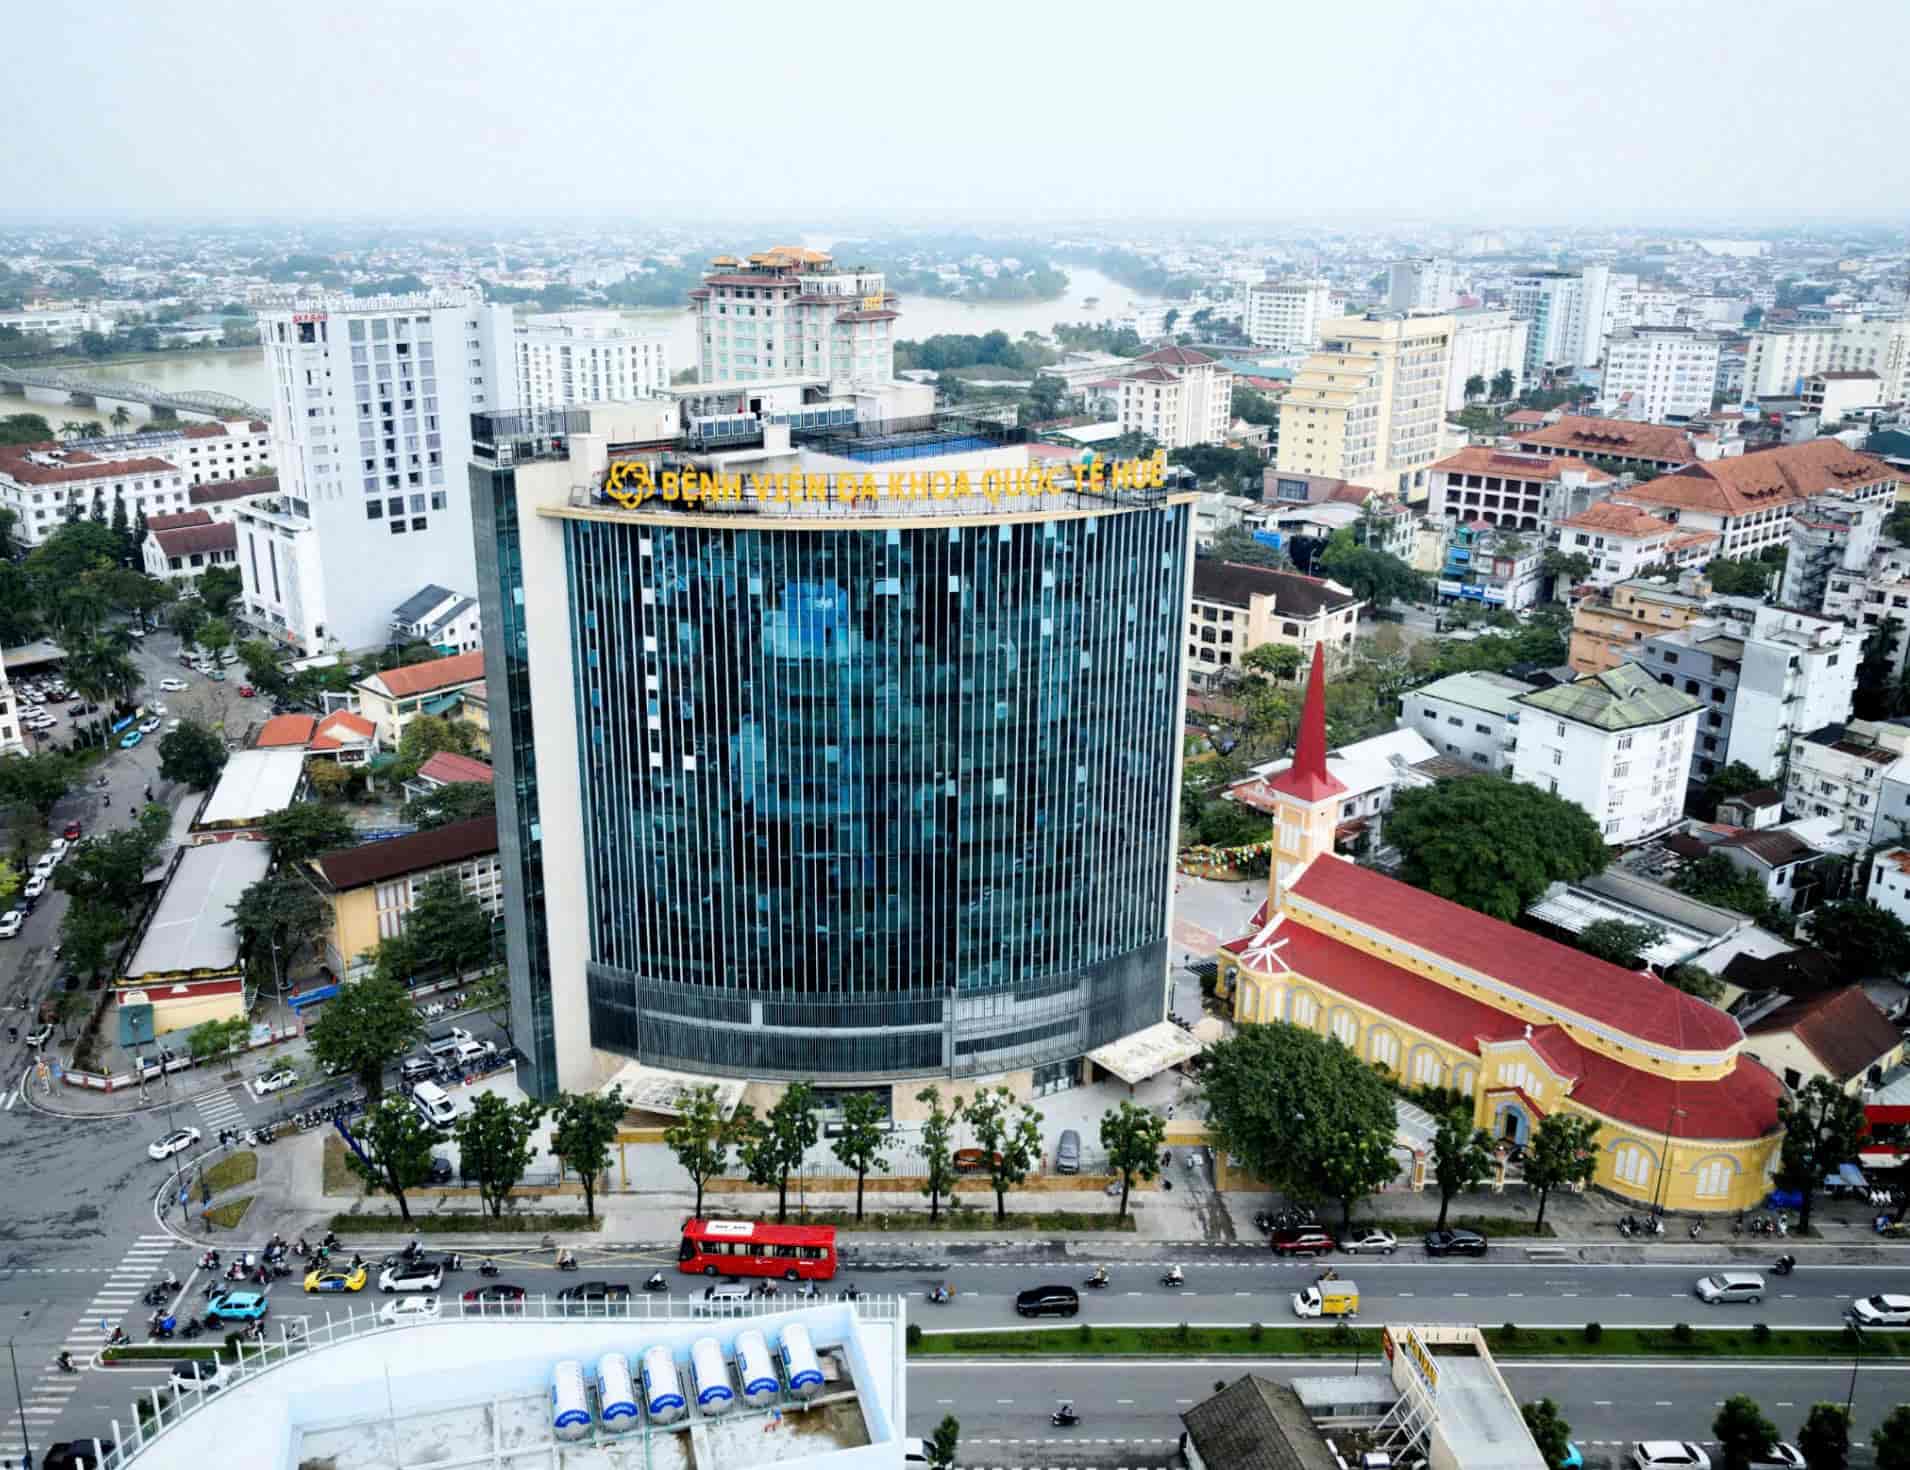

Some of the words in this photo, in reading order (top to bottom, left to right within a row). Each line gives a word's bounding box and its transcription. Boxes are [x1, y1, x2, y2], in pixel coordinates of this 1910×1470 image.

[661, 463, 742, 507] BỆNH
[887, 471, 973, 501] KHOA
[980, 456, 1064, 506] QUỐC
[1071, 450, 1106, 493] TẾ
[1111, 448, 1167, 490] HUẾ
